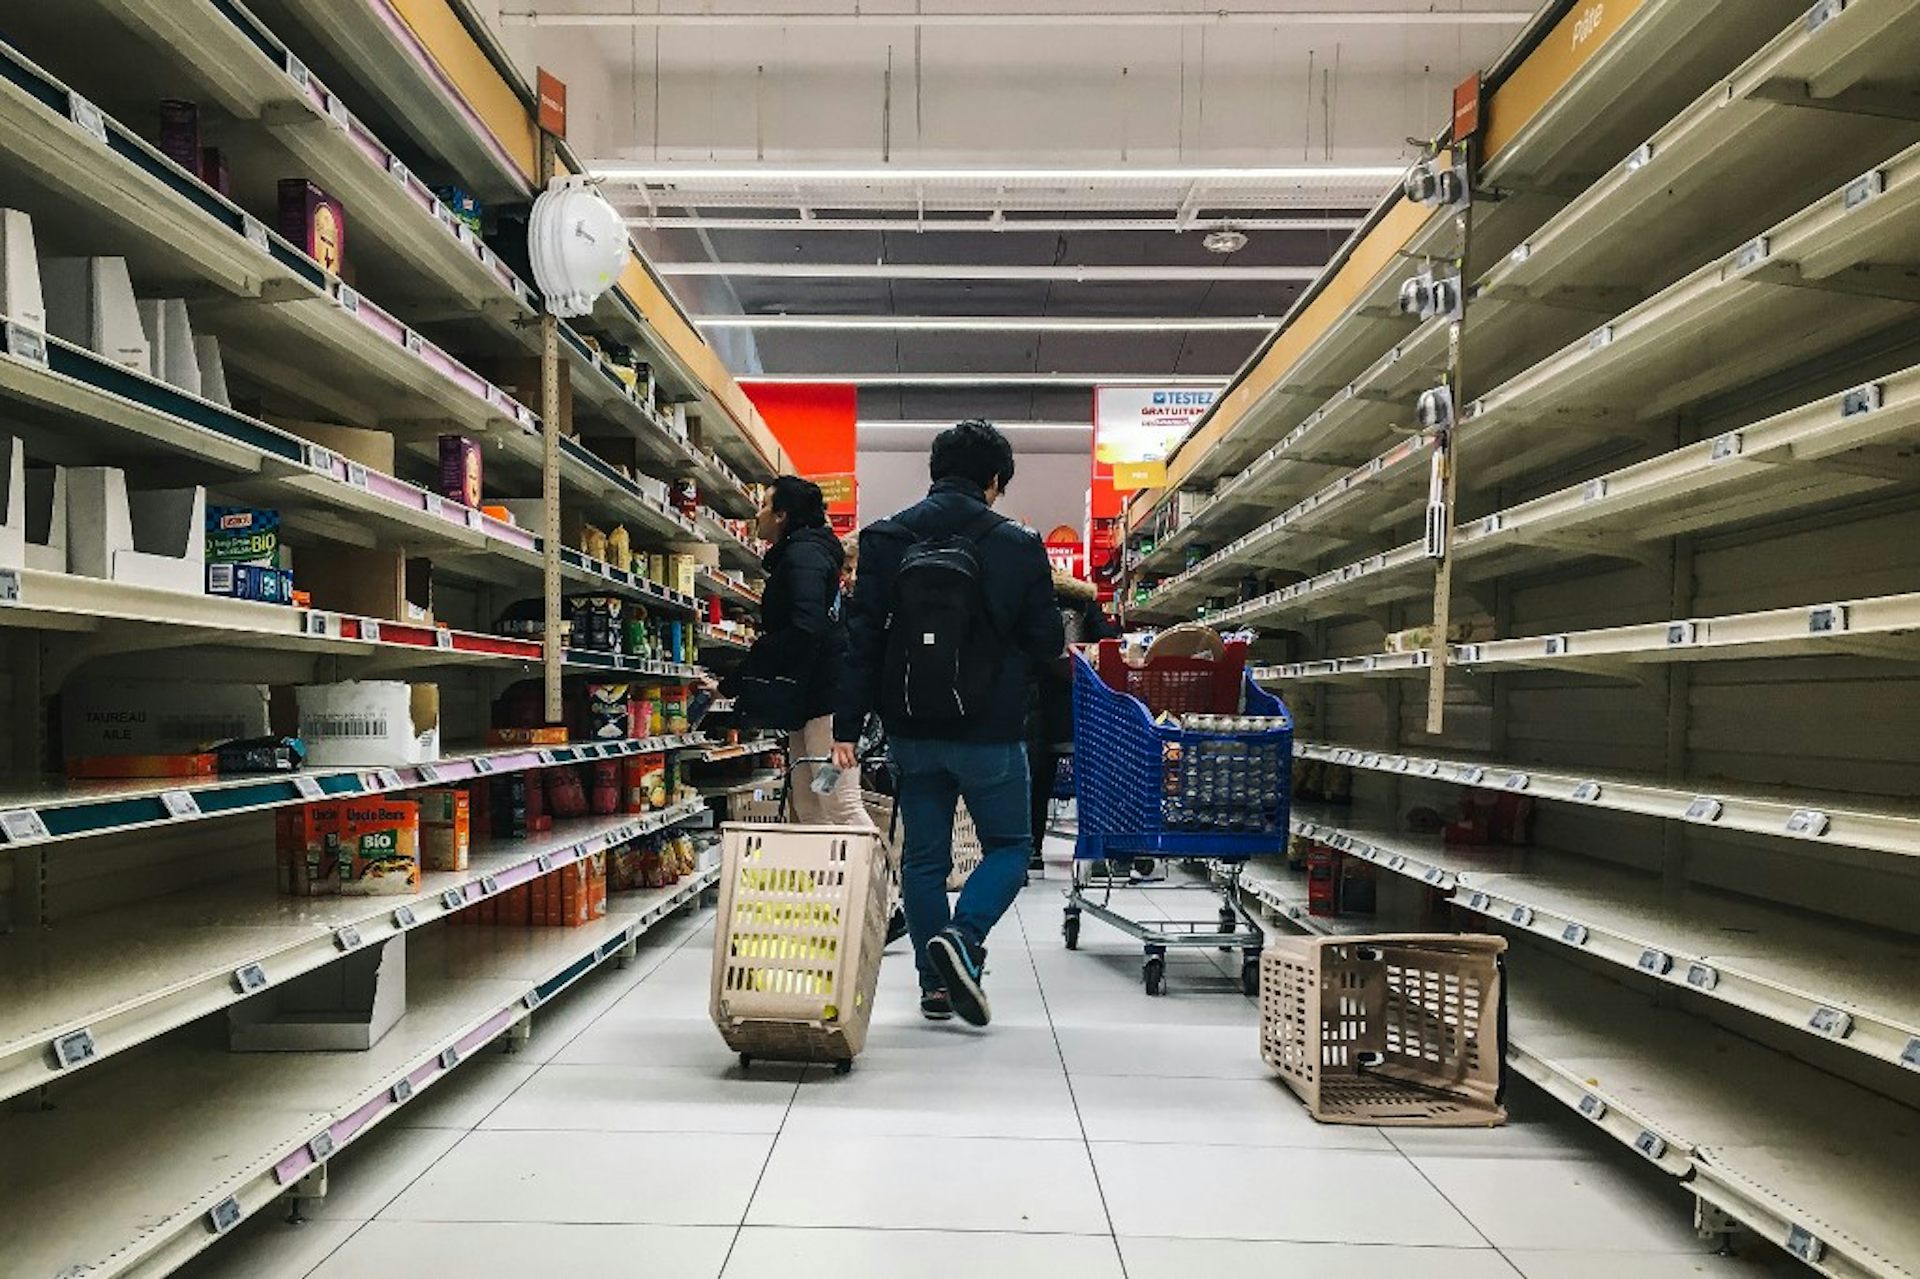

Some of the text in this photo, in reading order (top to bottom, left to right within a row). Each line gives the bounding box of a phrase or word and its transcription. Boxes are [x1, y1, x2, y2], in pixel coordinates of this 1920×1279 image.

[1571, 3, 1603, 51] Pâte
[1167, 392, 1214, 404] TESTEZ
[87, 711, 145, 724] TAUREAU
